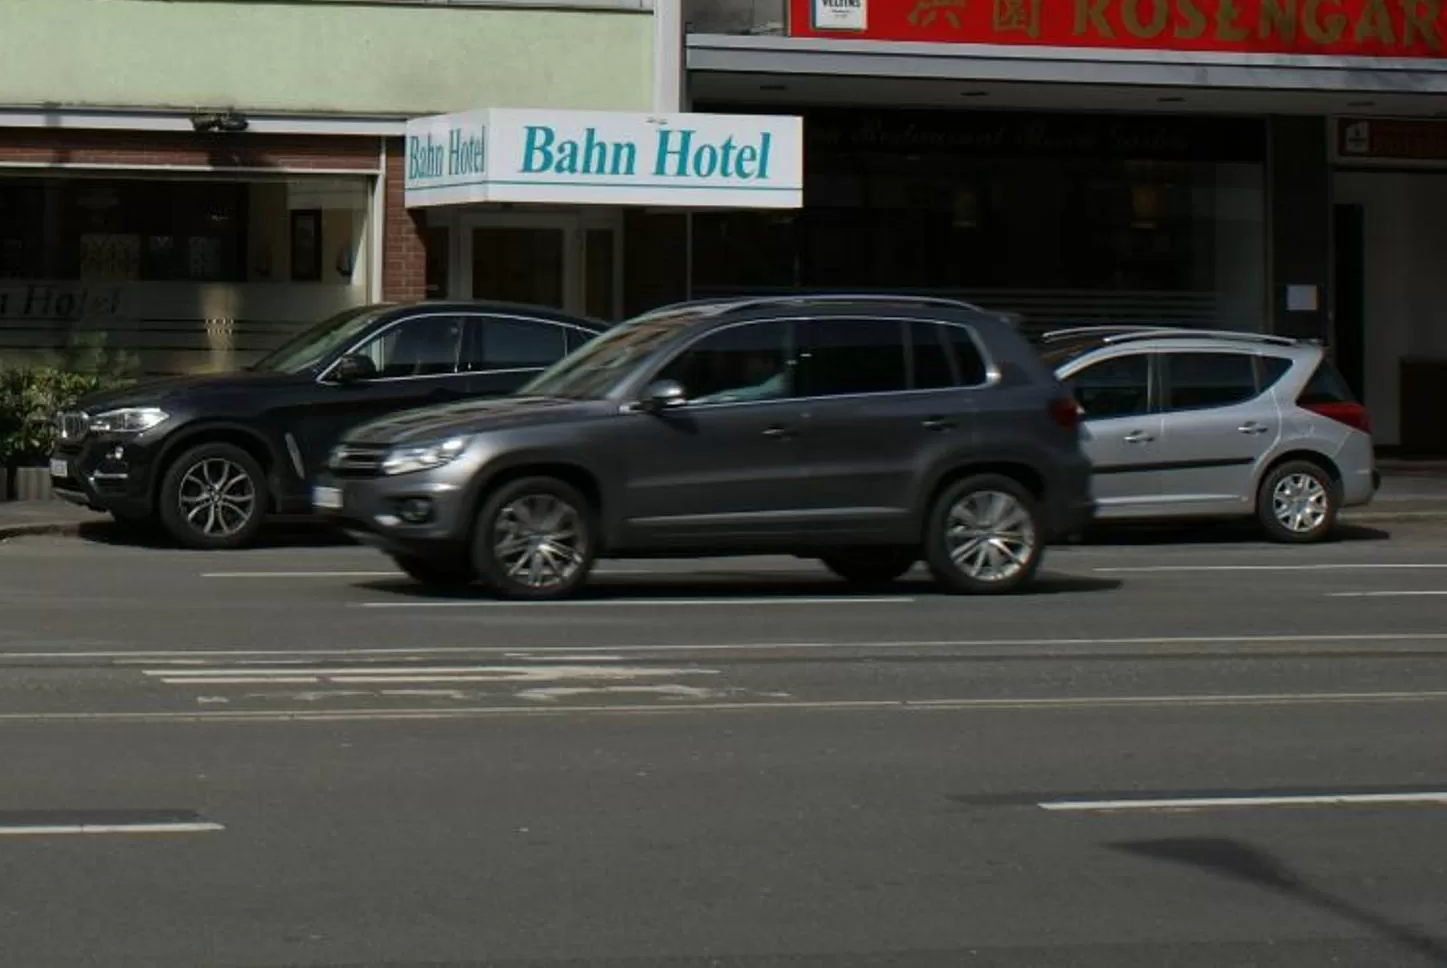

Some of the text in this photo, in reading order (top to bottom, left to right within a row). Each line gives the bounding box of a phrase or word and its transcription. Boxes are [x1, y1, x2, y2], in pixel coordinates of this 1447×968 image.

[408, 124, 486, 181] Bahn Hotel
[518, 124, 772, 180] Bahn Hotel
